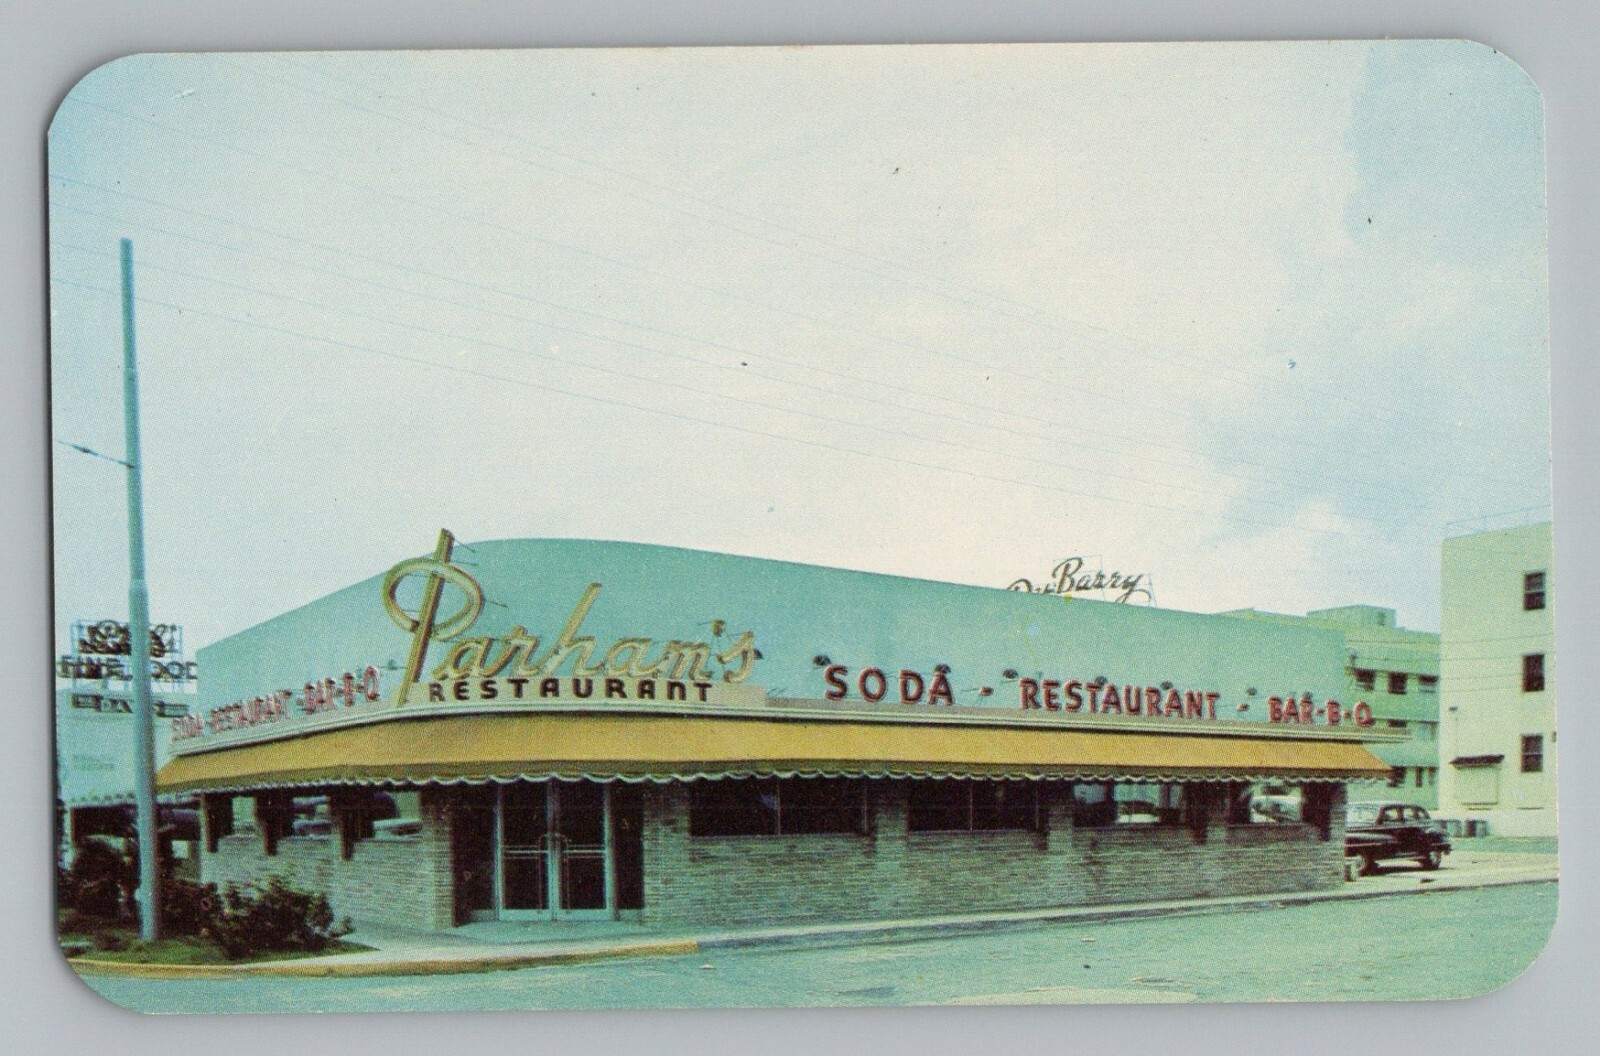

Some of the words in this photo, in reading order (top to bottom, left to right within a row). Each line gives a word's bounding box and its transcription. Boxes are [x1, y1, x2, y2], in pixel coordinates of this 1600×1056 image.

[383, 528, 757, 704] Parham's
[428, 678, 714, 701] RESTAURANT
[824, 664, 955, 706] SODA
[1018, 677, 1221, 722] RESTAURANT
